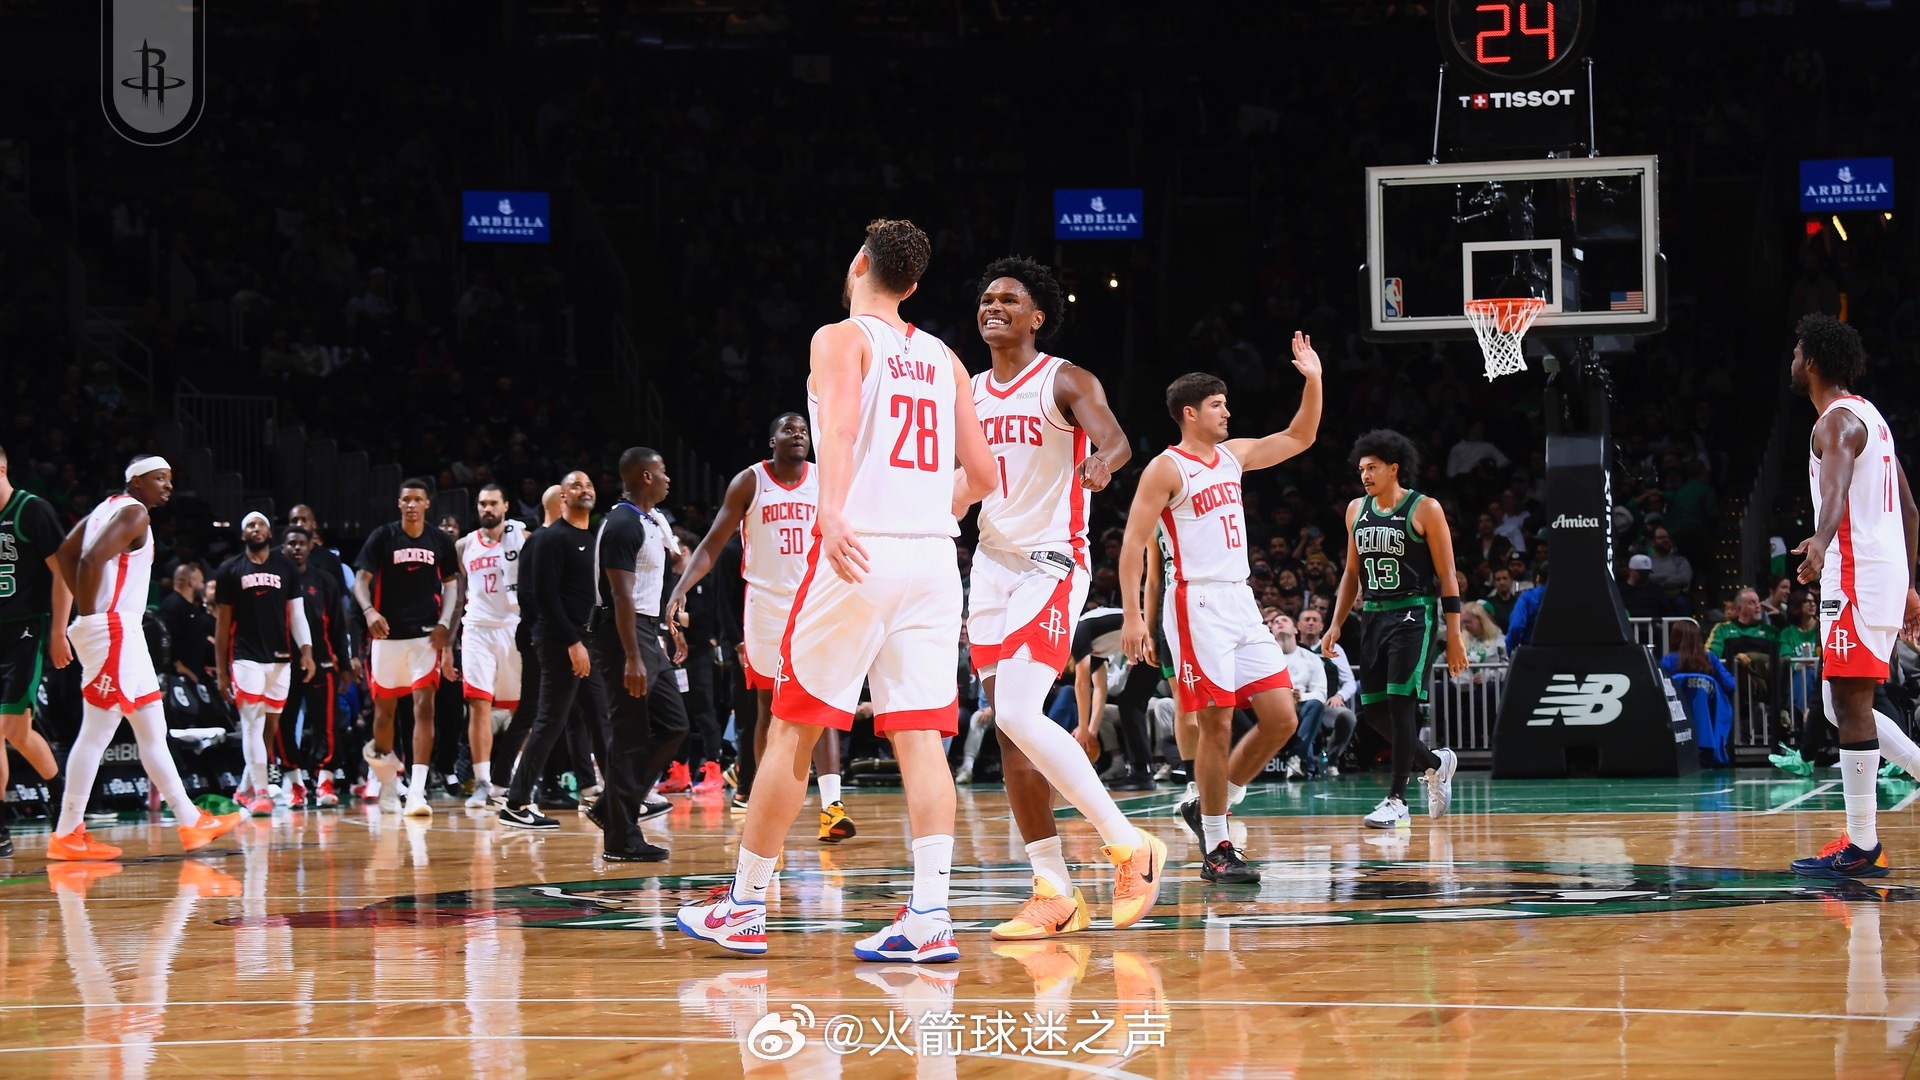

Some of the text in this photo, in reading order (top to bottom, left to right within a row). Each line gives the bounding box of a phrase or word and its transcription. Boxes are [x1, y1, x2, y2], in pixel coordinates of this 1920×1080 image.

[1476, 2, 1555, 63] 24
[1490, 89, 1575, 108] TISSOT
[1805, 182, 1888, 196] ARBELLA
[1816, 195, 1877, 204] INSURANCE
[468, 215, 544, 228] ARBELLA
[1060, 213, 1138, 224] ARBELLA
[889, 394, 939, 473] 28
[980, 415, 1043, 447] CKETS
[998, 455, 1008, 499] 1
[1220, 513, 1241, 549] 15
[1551, 513, 1599, 529] Amica
[779, 527, 804, 555] 30
[1354, 526, 1405, 557] CELTICS
[393, 547, 435, 565] ROCKETS
[241, 572, 282, 590] ROCKETS
[483, 573, 498, 593] 12
[1364, 557, 1400, 590] 13
[100, 743, 139, 766] etBl
